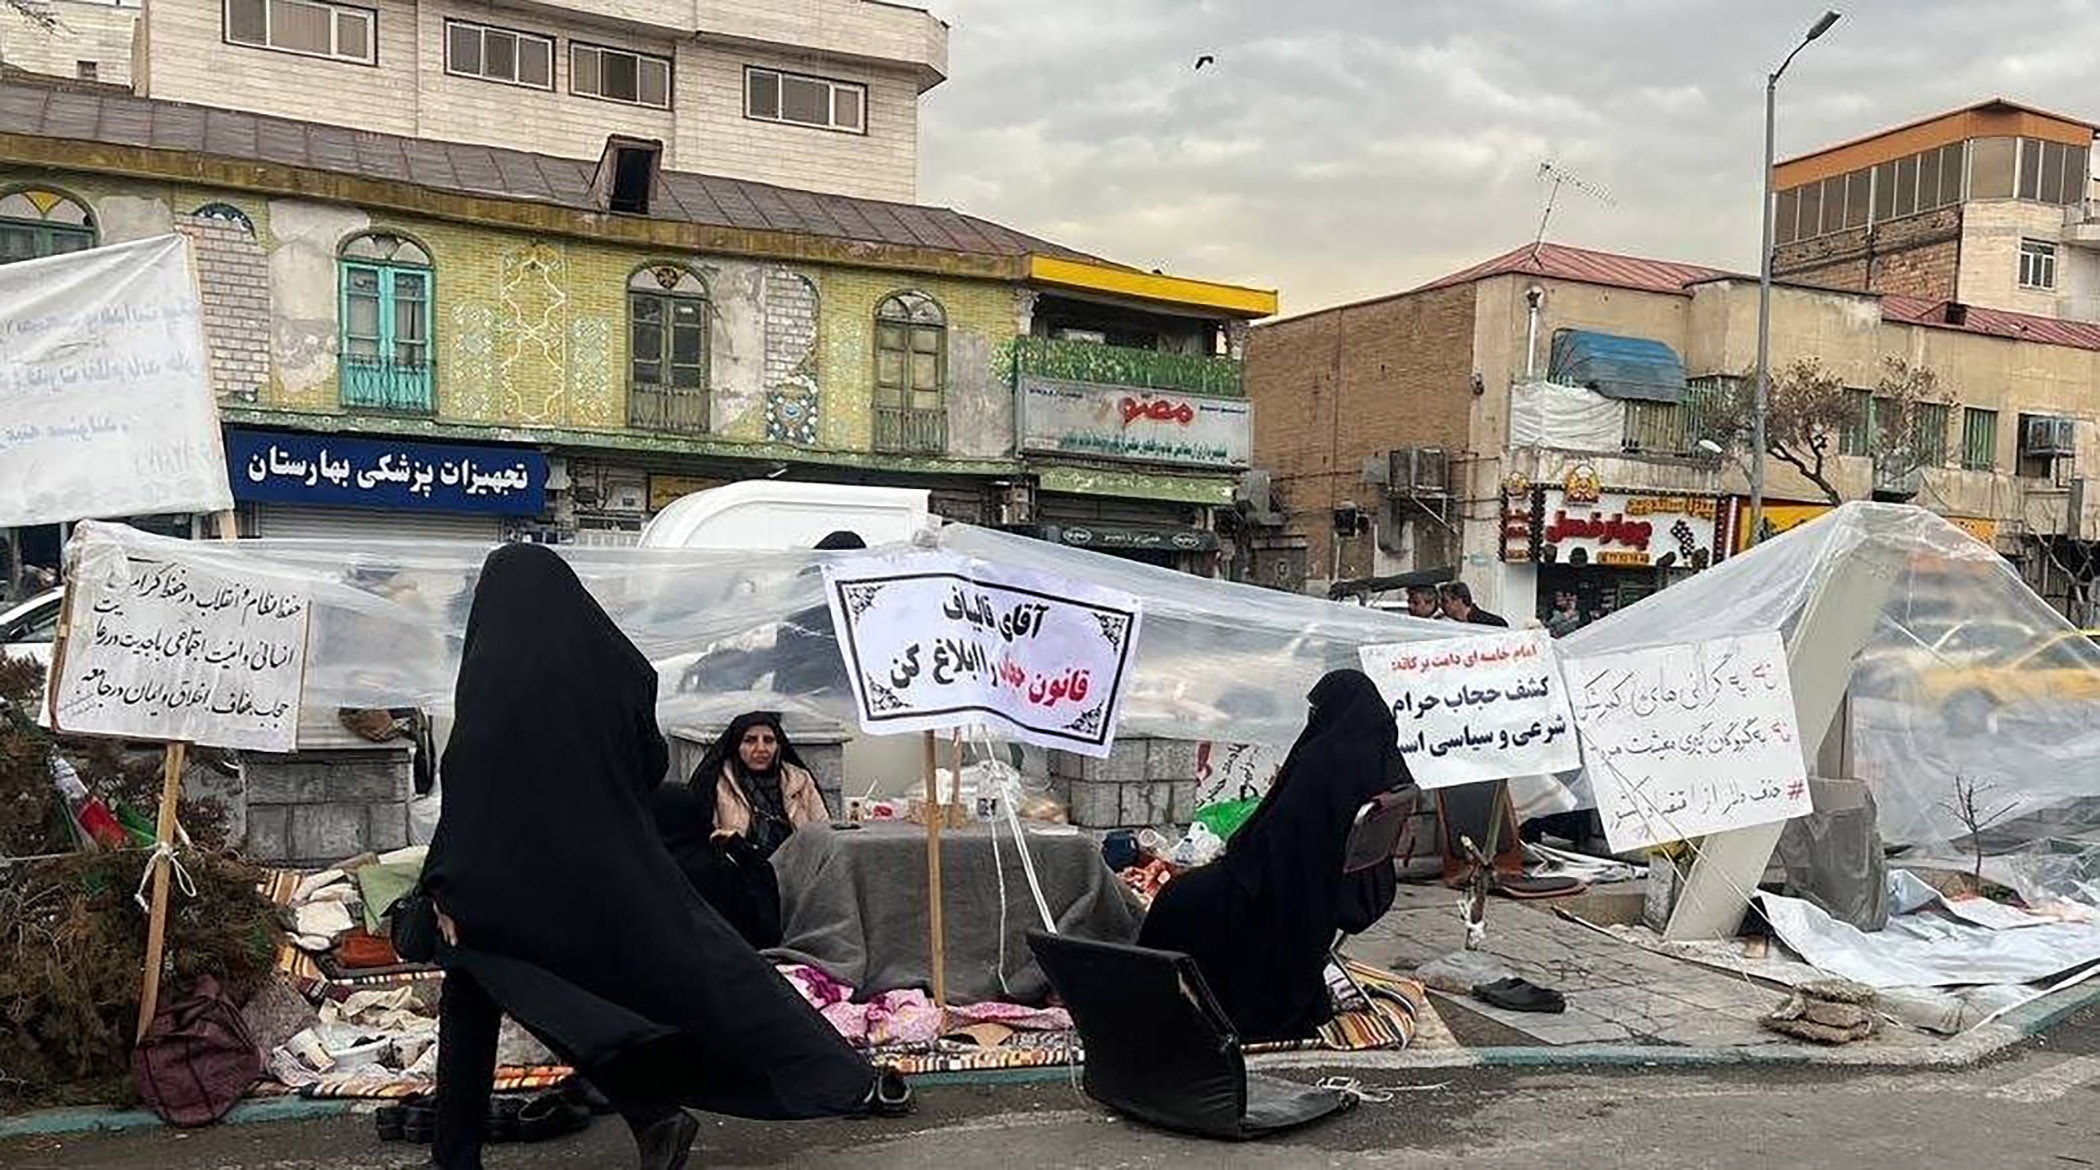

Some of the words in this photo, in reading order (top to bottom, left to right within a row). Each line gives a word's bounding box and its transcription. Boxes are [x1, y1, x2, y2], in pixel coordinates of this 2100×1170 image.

[247, 445, 351, 487] بهارستان
[356, 453, 434, 497] پزشکی
[440, 459, 529, 496] تجهیزات
[160, 569, 189, 598] حفظ
[181, 592, 195, 604] در
[196, 583, 240, 616] انقلاب
[241, 590, 277, 626] نظام
[277, 596, 302, 619] حفظ
[998, 602, 1049, 642] آقای
[120, 634, 154, 659] جدیت
[163, 626, 206, 661] اجتماعی
[251, 641, 294, 670] انسانی
[890, 643, 920, 689] کن
[124, 680, 162, 716] ایمان
[168, 681, 211, 709] اخلاق
[1028, 668, 1090, 708] قانون
[1445, 685, 1500, 713] حجاب
[1505, 675, 1549, 700] کشف
[1392, 691, 1440, 719] حرام
[1399, 731, 1424, 754] اس
[1429, 725, 1494, 757] سیاسی
[1499, 729, 1507, 750] و
[1512, 715, 1566, 746] شرعی
[1749, 780, 1782, 800] حذف
